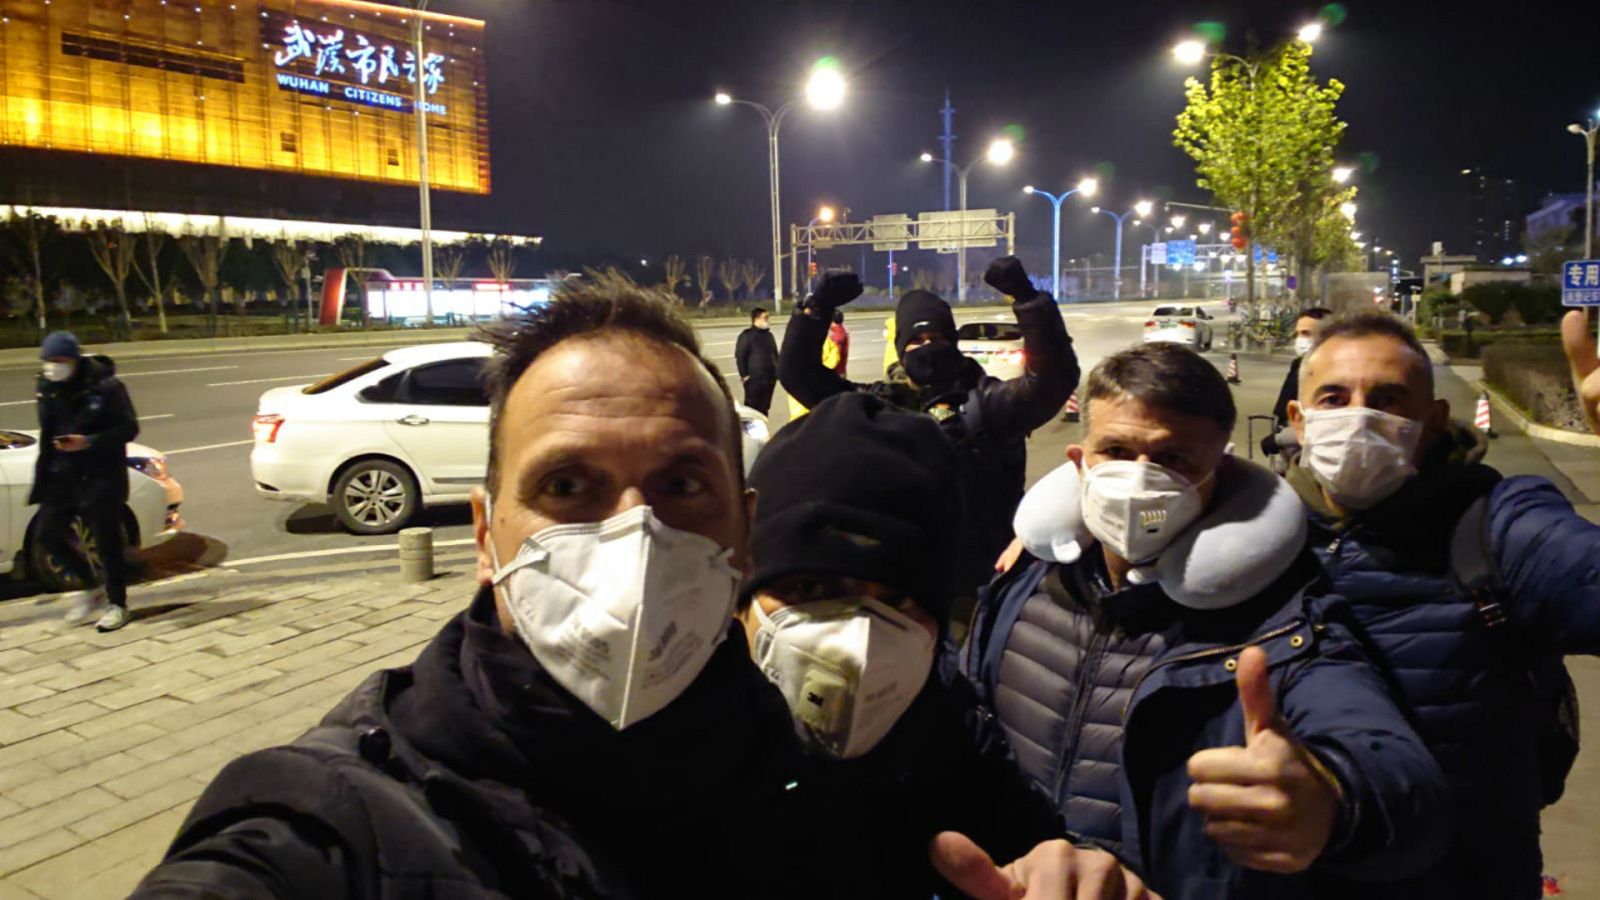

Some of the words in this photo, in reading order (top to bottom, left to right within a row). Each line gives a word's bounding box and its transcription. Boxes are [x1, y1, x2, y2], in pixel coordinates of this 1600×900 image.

[276, 73, 330, 94] WUHAN
[344, 87, 402, 108] CITIZENS
[1568, 264, 1599, 286] 专用
